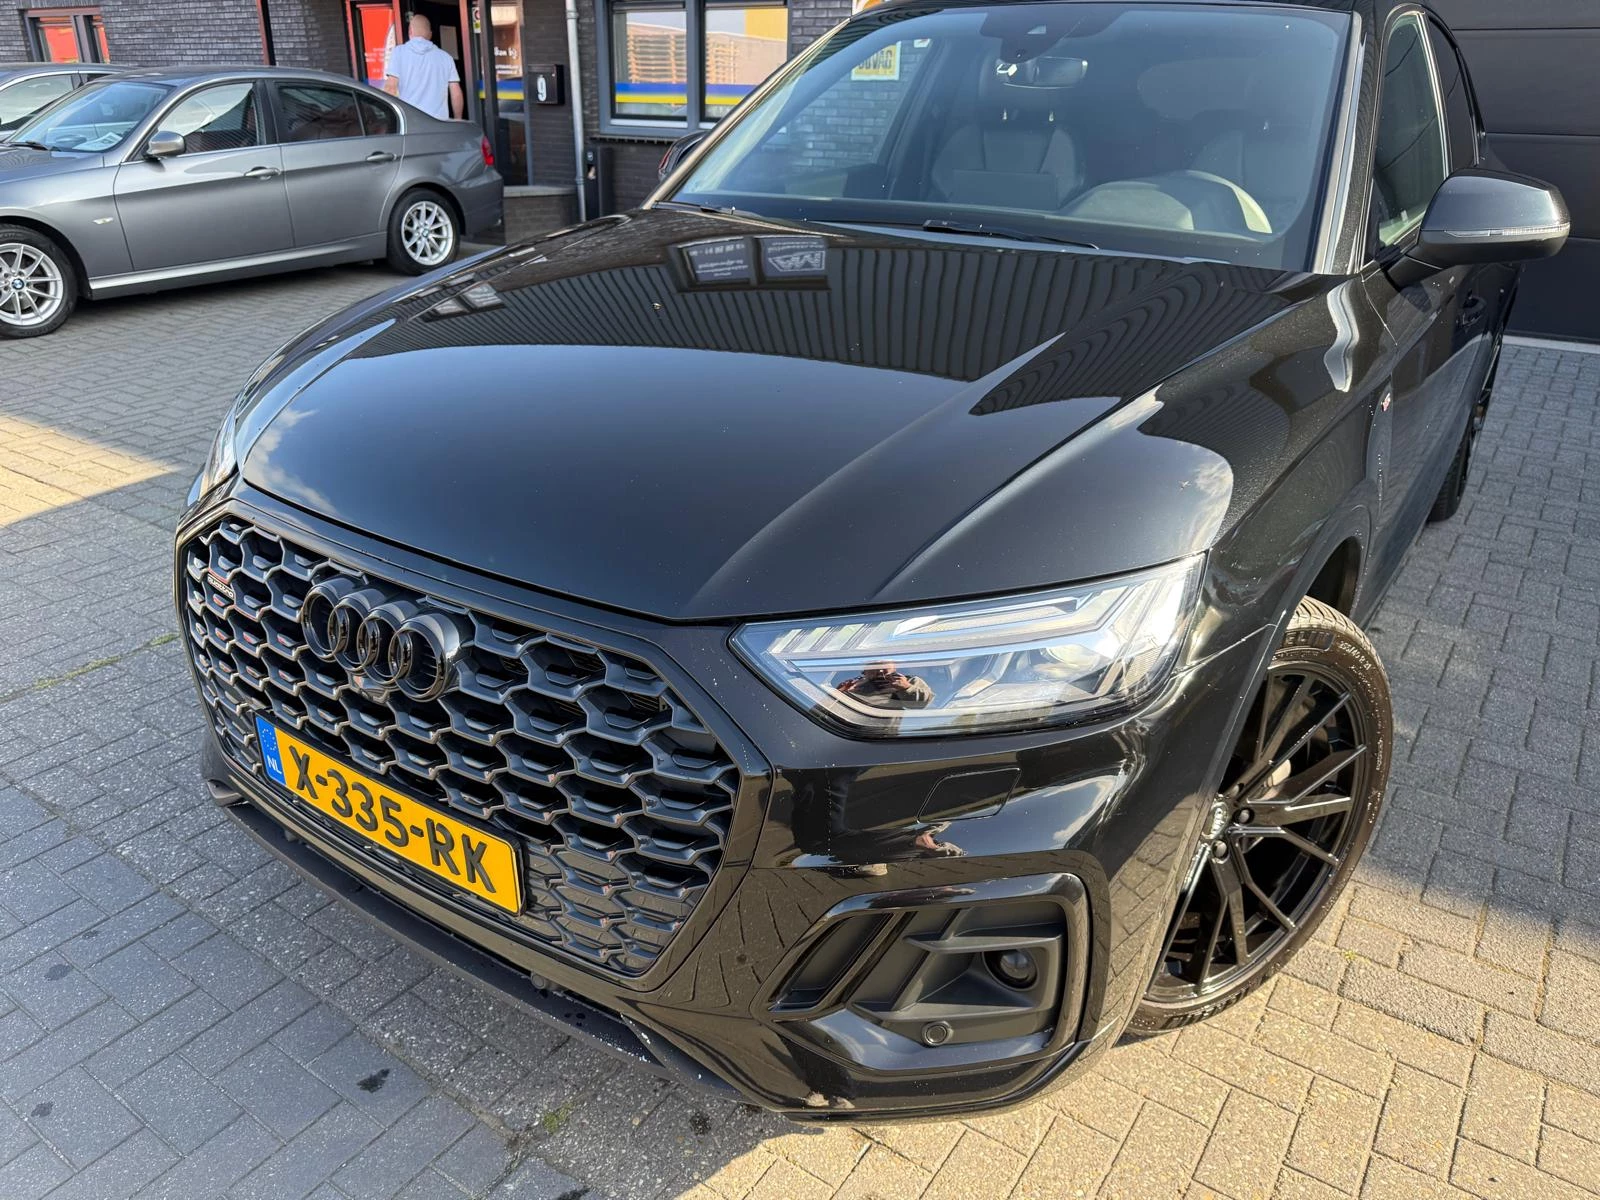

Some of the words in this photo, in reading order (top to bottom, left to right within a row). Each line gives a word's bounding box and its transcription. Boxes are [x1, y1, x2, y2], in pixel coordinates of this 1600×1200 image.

[537, 75, 547, 102] 9
[267, 756, 283, 775] NL
[289, 745, 497, 894] X-335-RK
